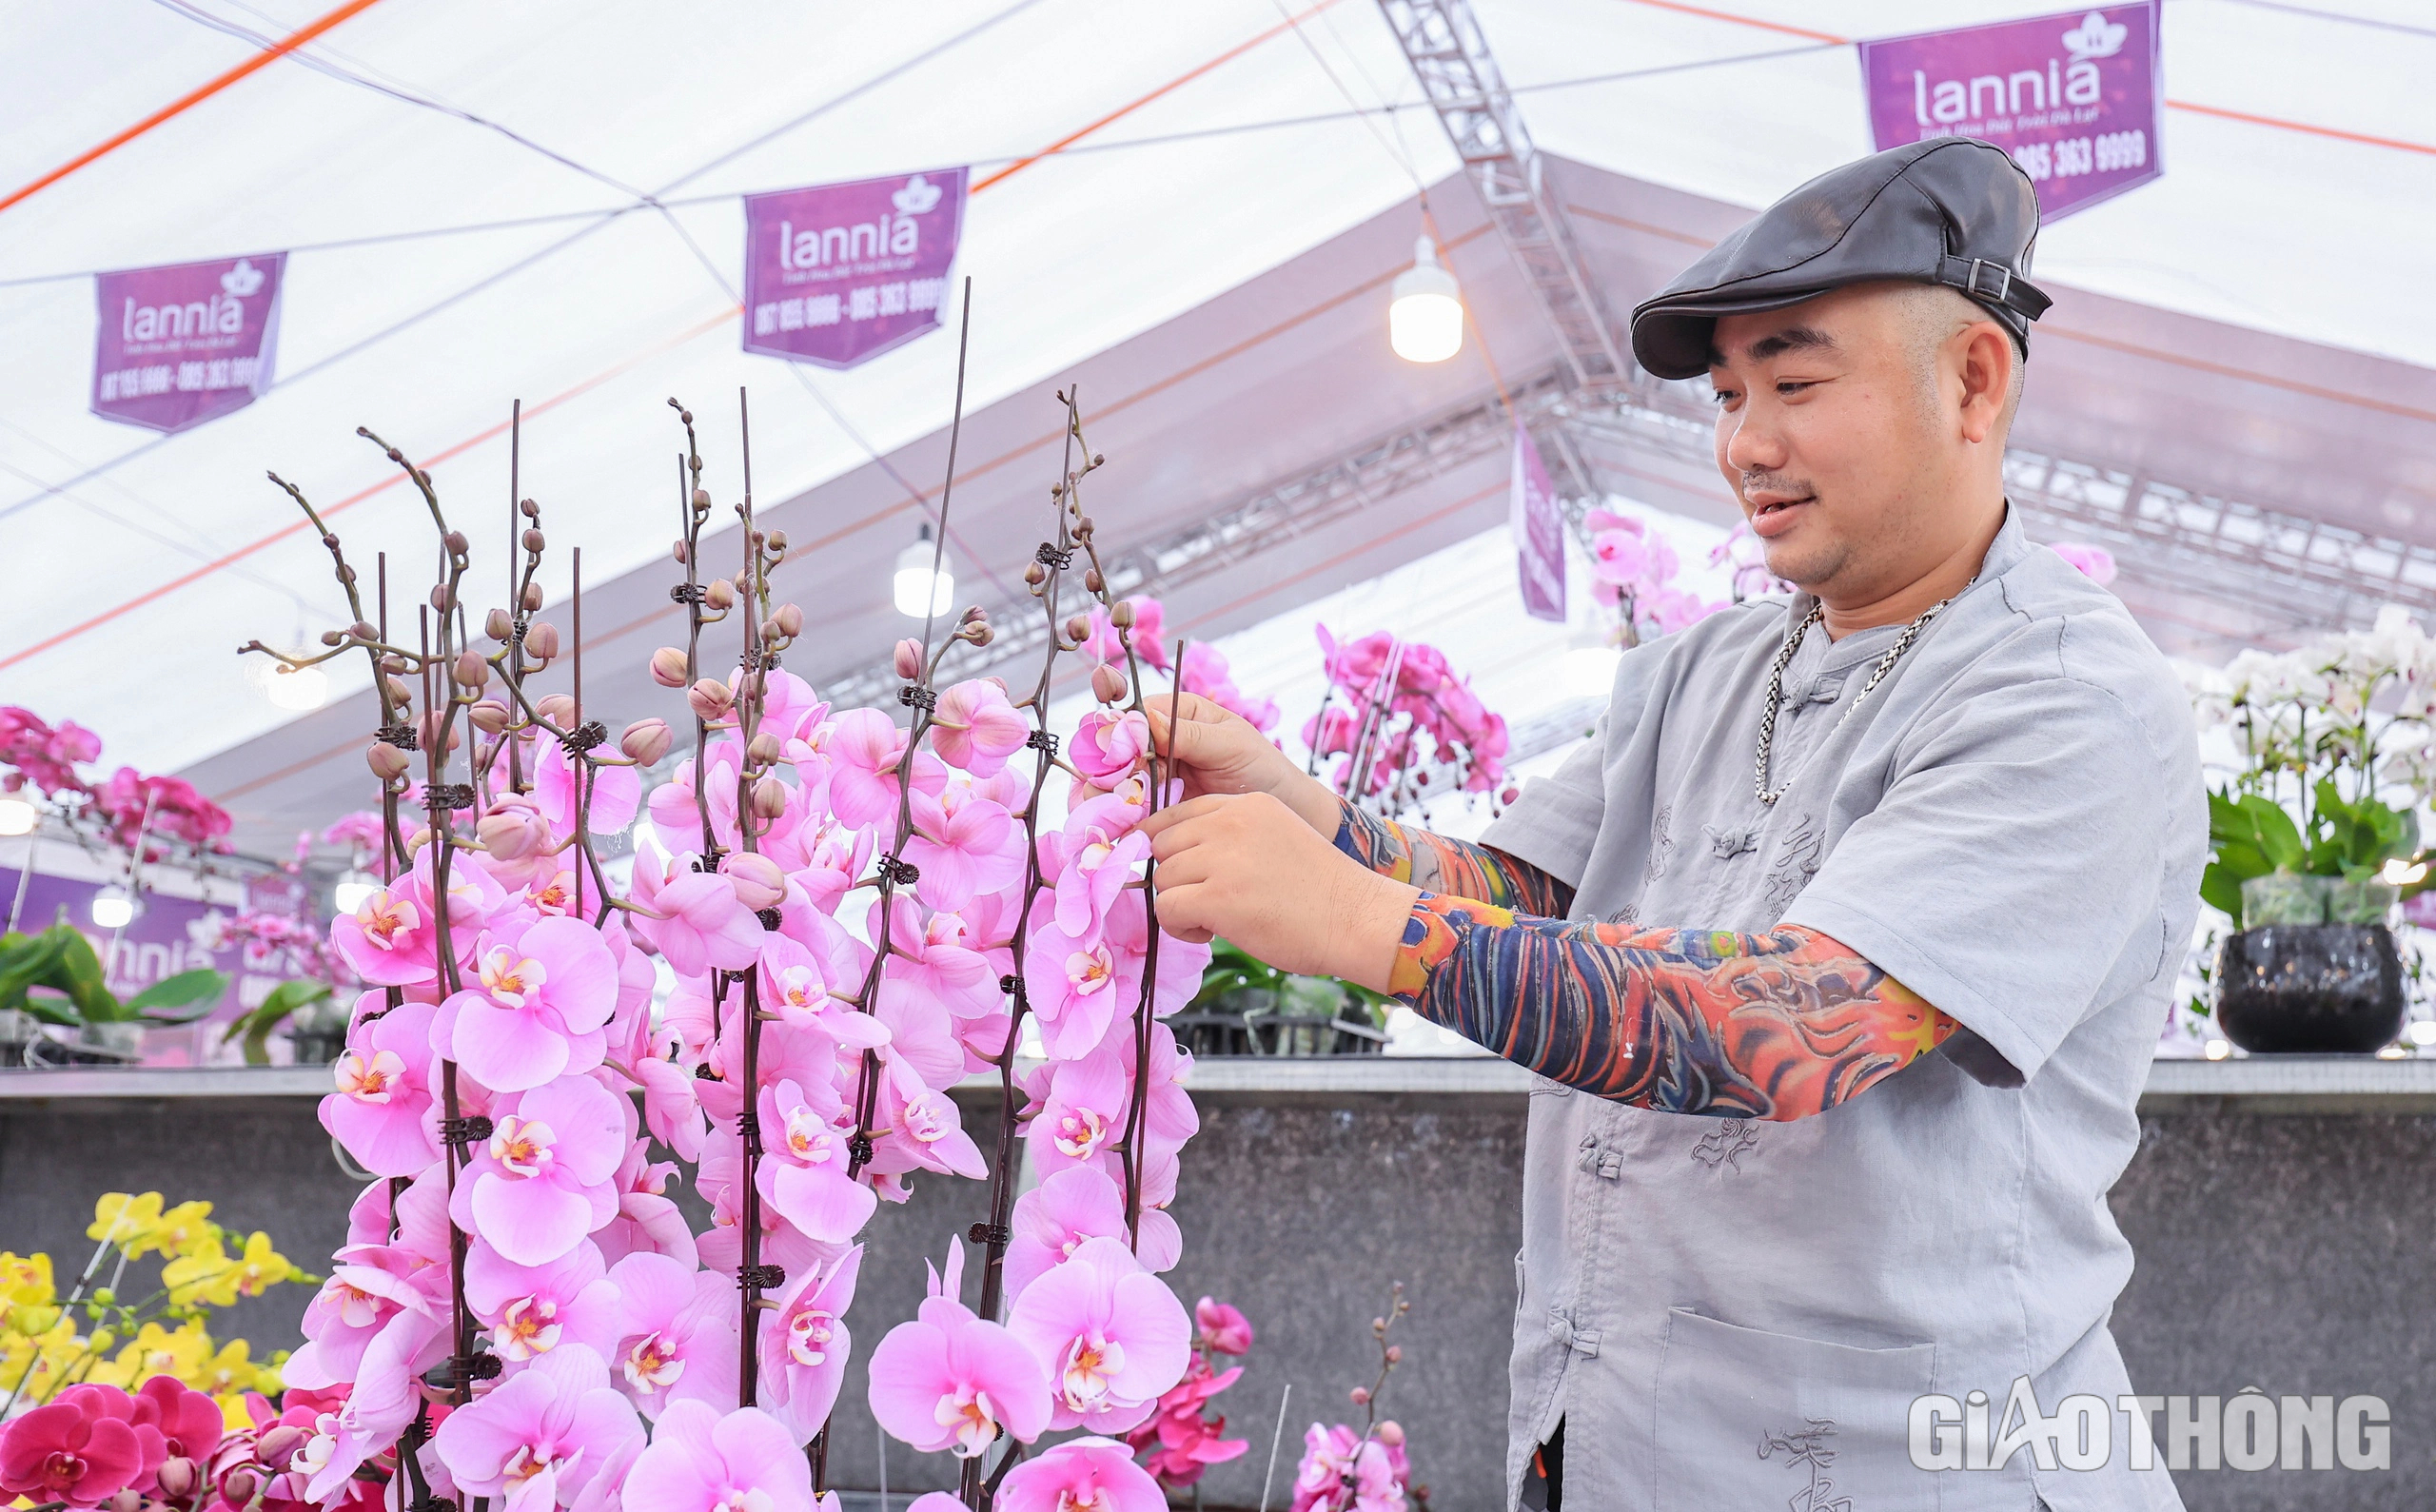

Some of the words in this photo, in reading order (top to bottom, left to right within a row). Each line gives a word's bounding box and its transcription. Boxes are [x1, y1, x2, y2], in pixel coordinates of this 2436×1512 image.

[1914, 58, 2102, 126] lannia
[780, 213, 920, 270] lannia
[123, 294, 245, 343] lannia
